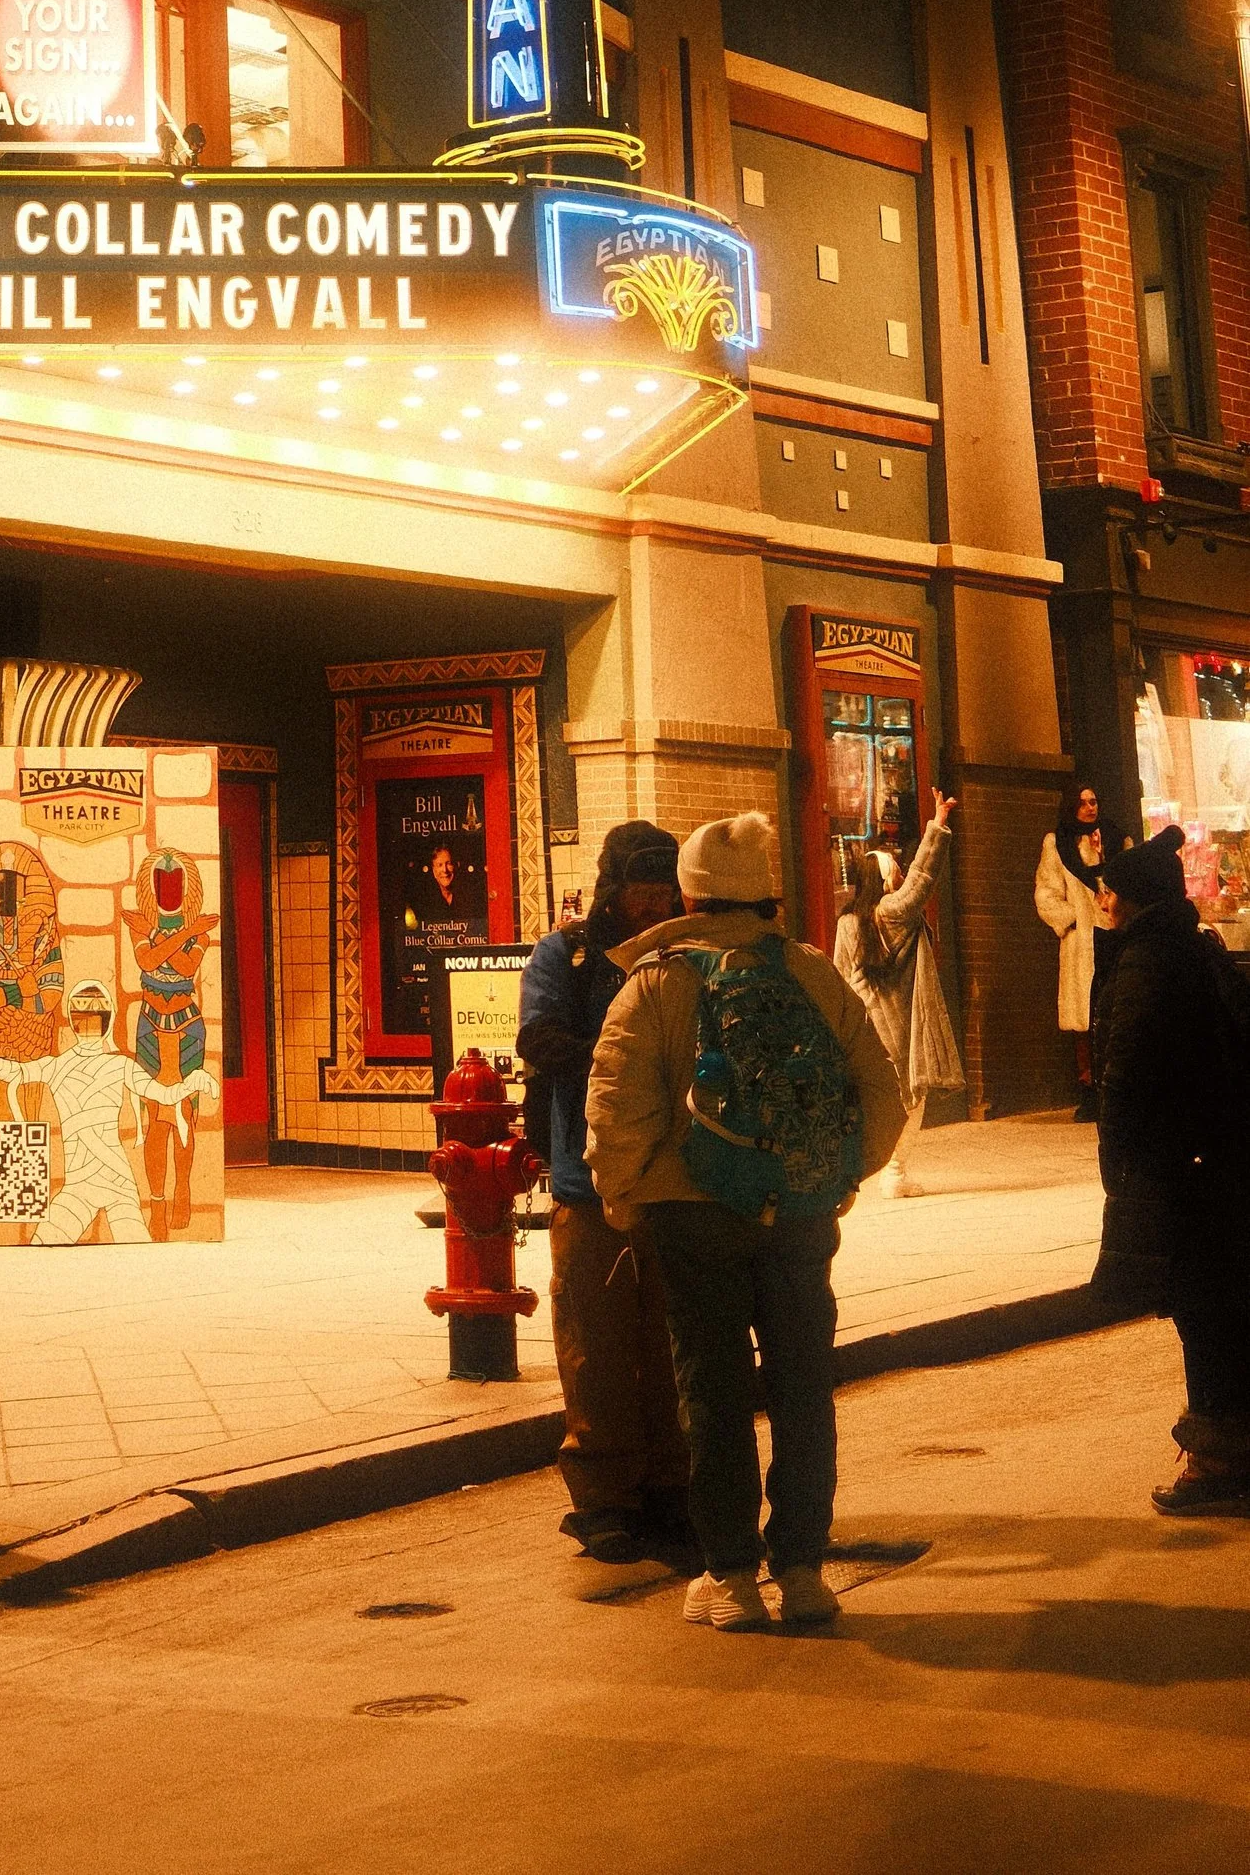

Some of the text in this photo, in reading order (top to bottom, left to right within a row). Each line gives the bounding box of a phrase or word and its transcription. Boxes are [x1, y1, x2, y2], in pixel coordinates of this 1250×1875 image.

[15, 0, 110, 32] YOUR
[14, 201, 246, 256] COLLAR
[266, 202, 519, 257] COMEDY
[595, 227, 726, 296] EGYPTIAN
[137, 275, 428, 330] ENGVALL
[821, 621, 914, 658] EGYPTIAN
[855, 660, 883, 671] THEATRE
[369, 703, 483, 731] EGYPTIAN
[401, 738, 452, 751] THEATRE
[20, 769, 143, 795] EGYPTIAN
[415, 796, 442, 812] Bill
[42, 805, 121, 820] THEATRE
[59, 823, 105, 831] PARK CITY
[401, 814, 458, 837] Engvall
[421, 920, 469, 934] Legendary
[405, 933, 488, 947] Blue Collar Comic
[445, 956, 479, 970] NOW
[457, 1011, 517, 1025] DEVOTCH
